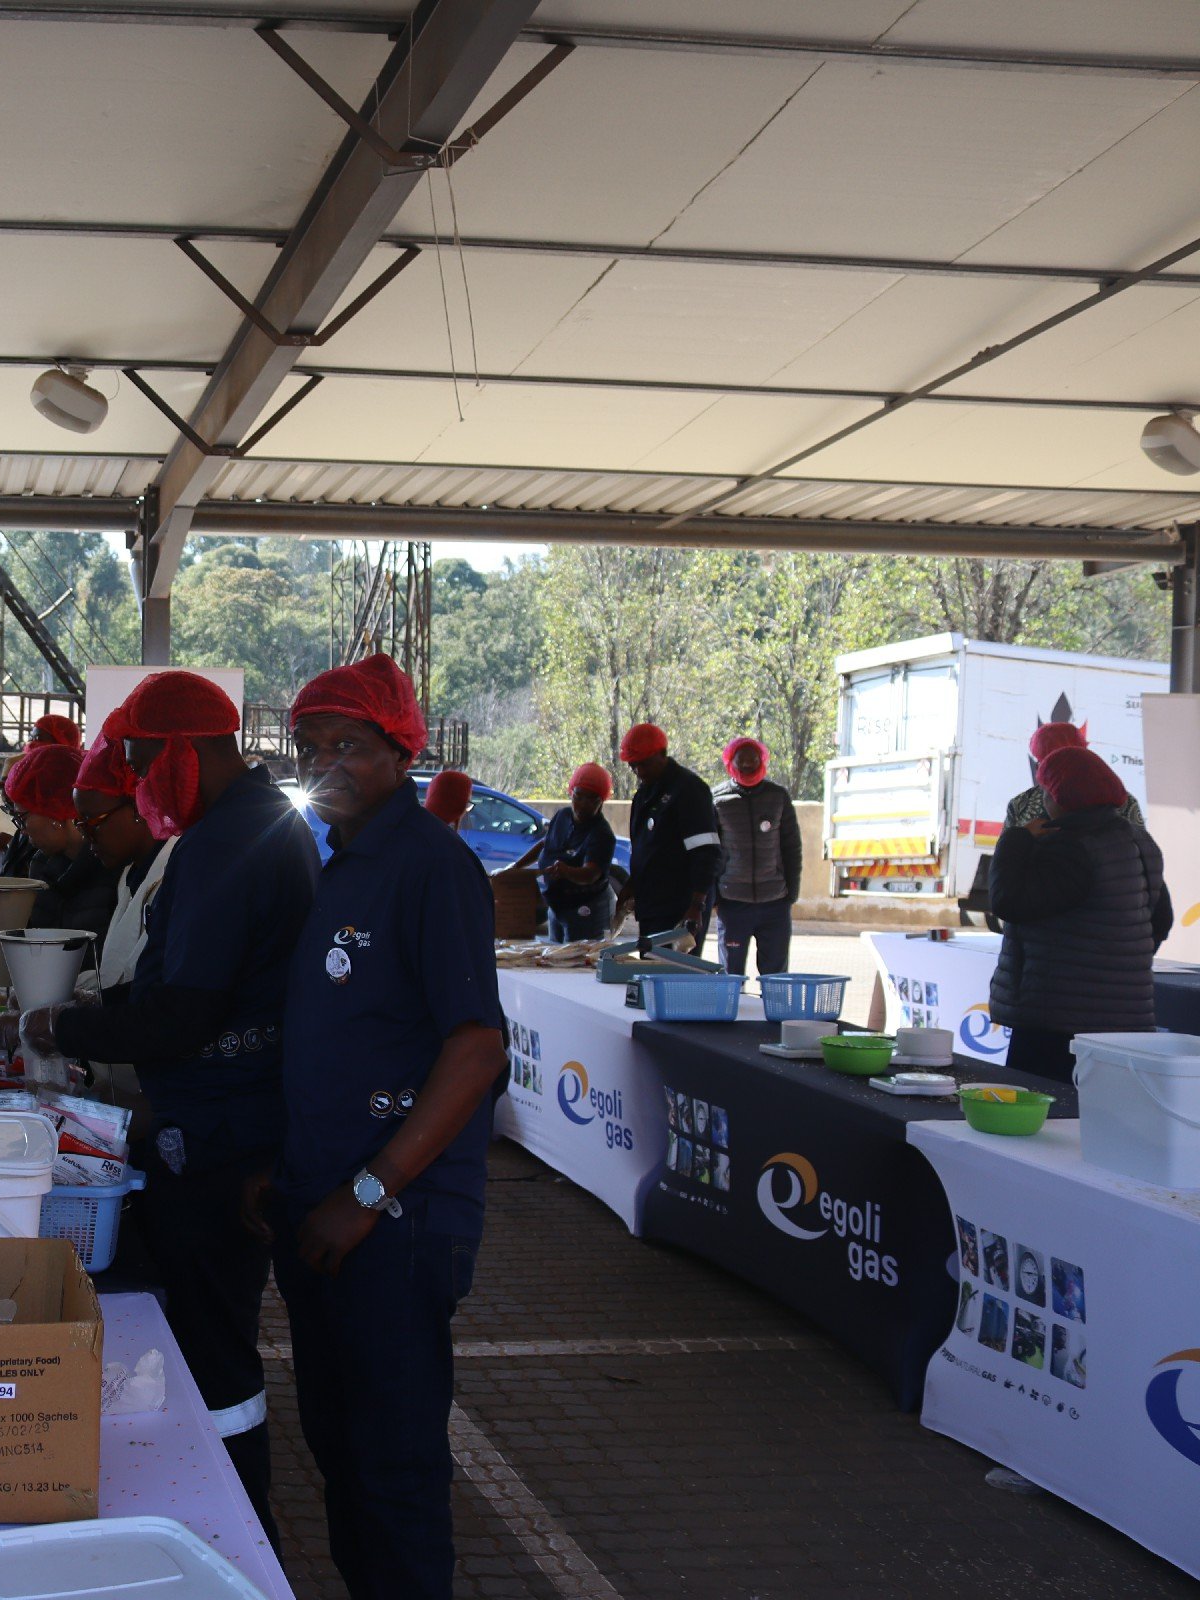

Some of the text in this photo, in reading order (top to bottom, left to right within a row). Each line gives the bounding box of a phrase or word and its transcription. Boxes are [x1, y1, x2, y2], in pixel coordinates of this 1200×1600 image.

[1122, 755, 1143, 766] This
[590, 1087, 623, 1120] egoli
[605, 1121, 634, 1151] gas
[819, 1191, 881, 1243] egoli
[848, 1241, 899, 1287] gas
[35, 1356, 61, 1365] Food)
[20, 1368, 45, 1377] ONLY
[0, 1414, 7, 1423] x
[10, 1413, 35, 1422] 1000
[37, 1412, 79, 1422] Sachets
[22, 1482, 50, 1492] 13.23
